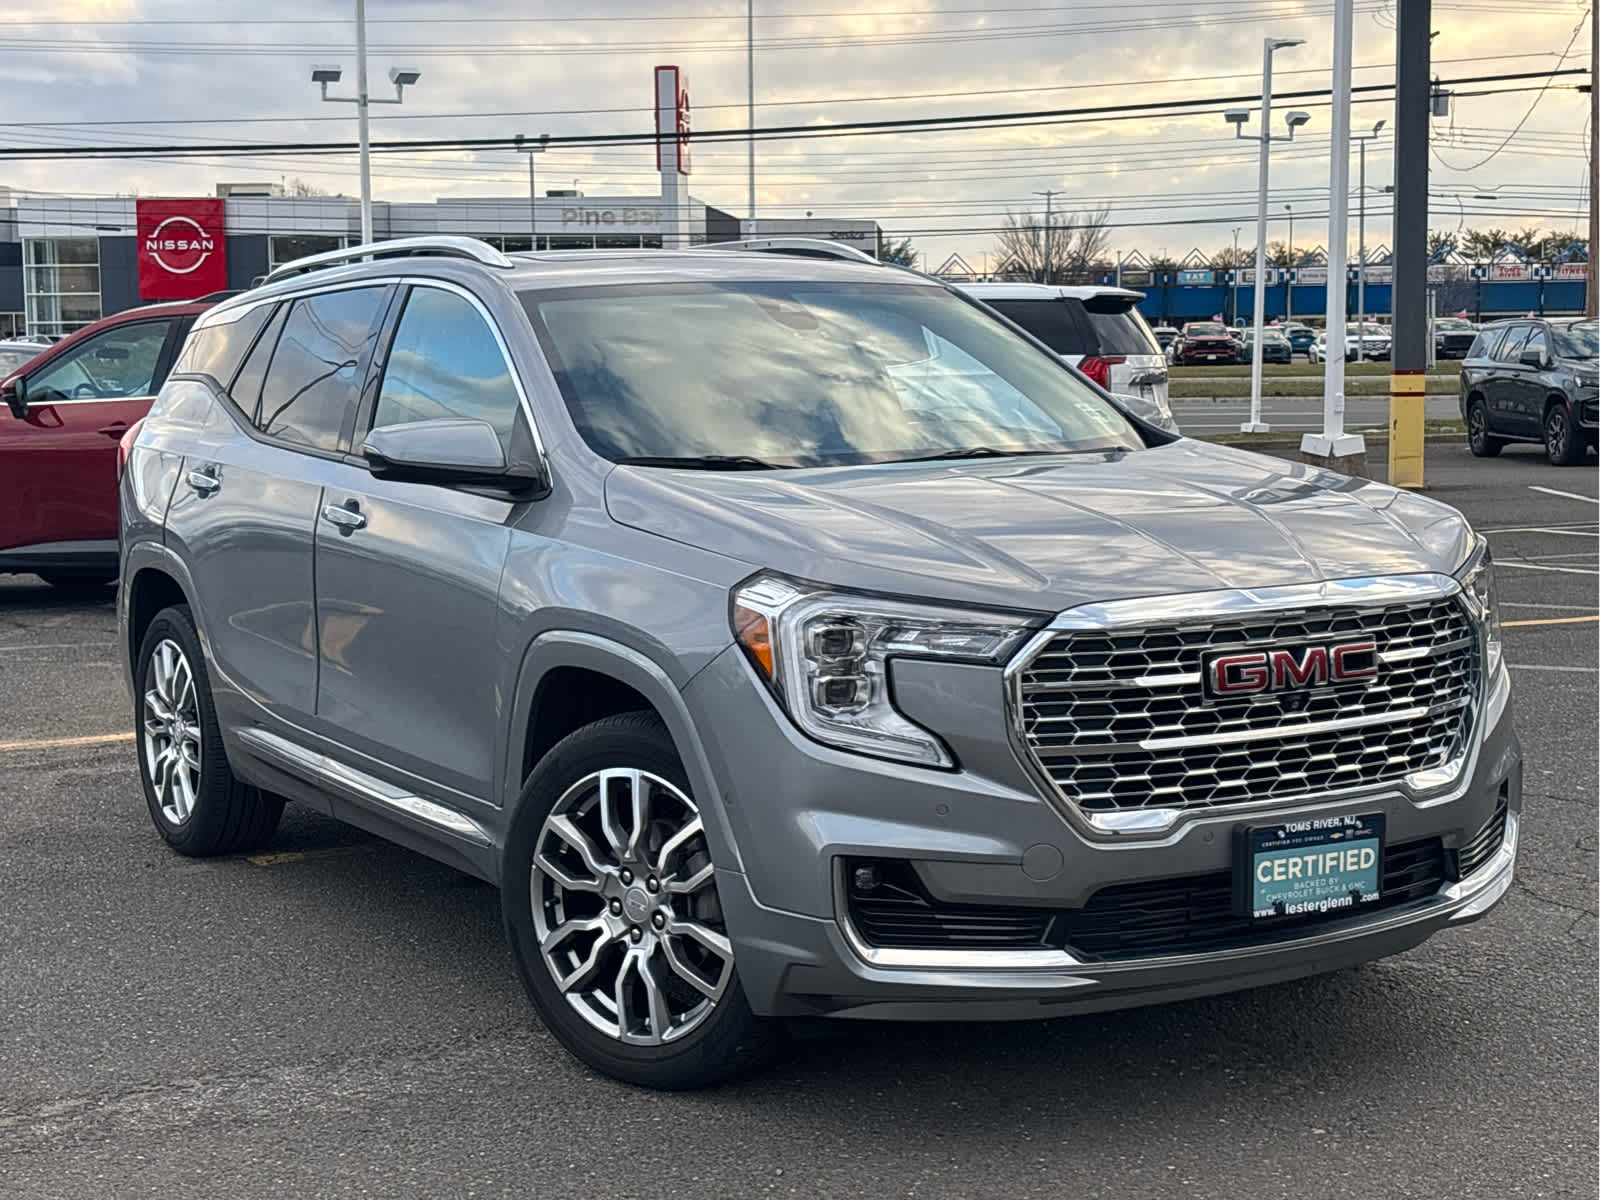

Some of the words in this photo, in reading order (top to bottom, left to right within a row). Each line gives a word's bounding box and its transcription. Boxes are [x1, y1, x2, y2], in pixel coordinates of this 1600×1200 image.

[561, 207, 616, 227] Pine
[146, 239, 214, 251] NISSAN
[1209, 641, 1378, 695] GMC
[1285, 820, 1312, 833] TOMS
[1344, 815, 1356, 825] NJ
[1257, 848, 1375, 883] CERTIFIED
[1294, 879, 1326, 890] BACKED
[1328, 877, 1339, 886] BY
[1266, 888, 1313, 902] CHEVROLET
[1315, 884, 1340, 896] BUICK
[1285, 896, 1352, 914] lesterglenn
